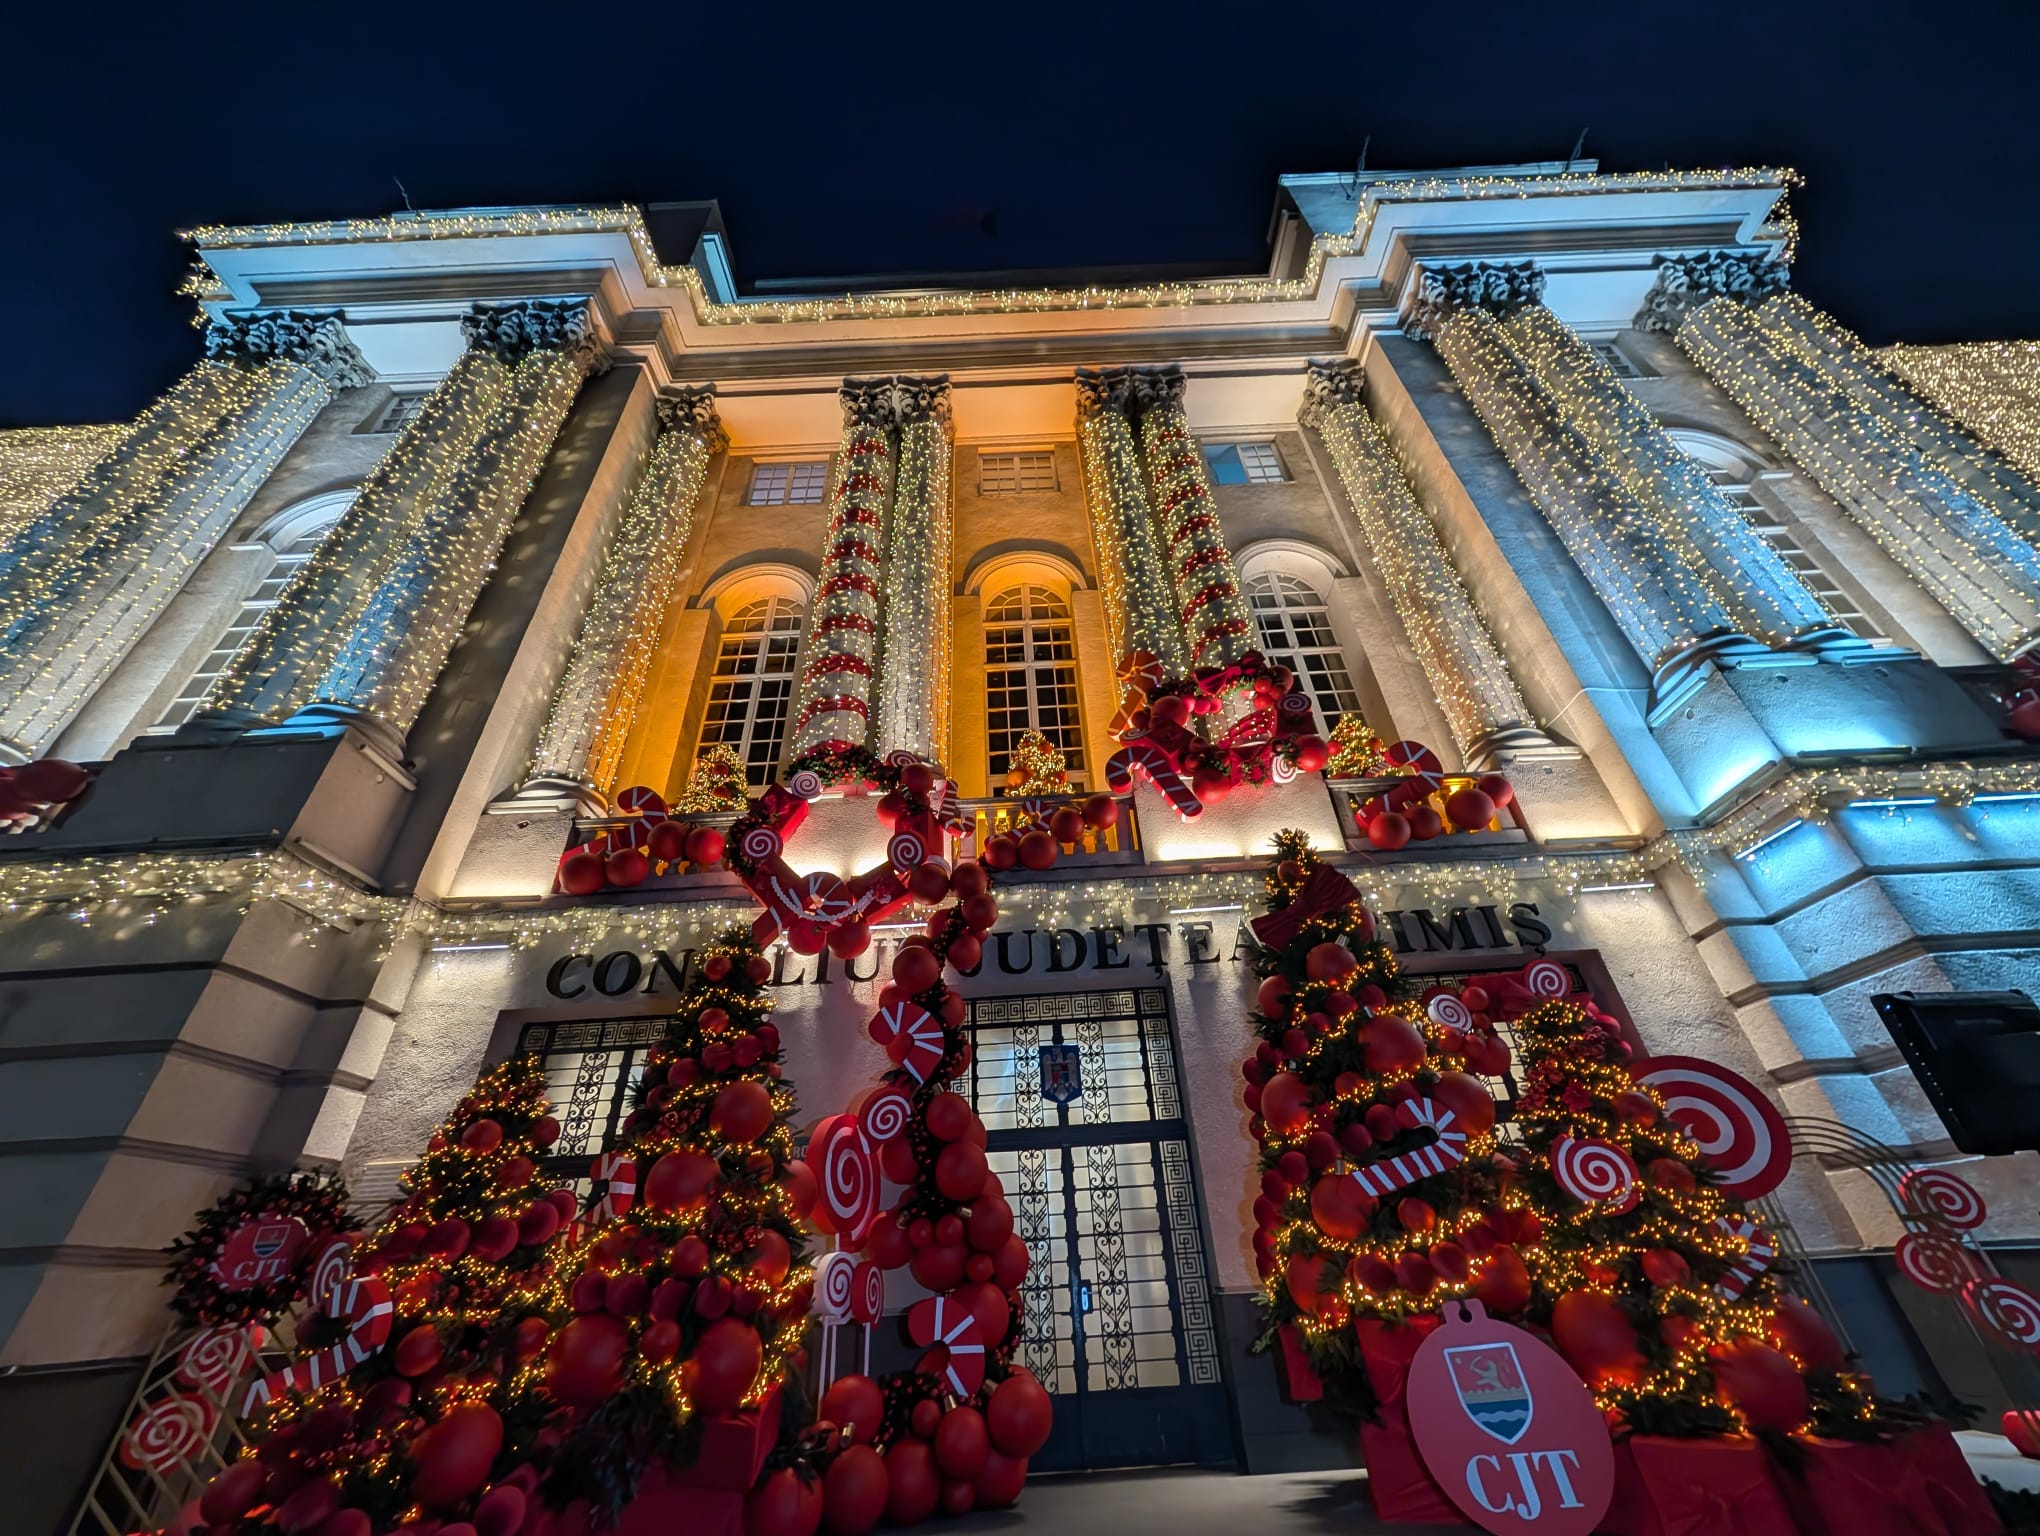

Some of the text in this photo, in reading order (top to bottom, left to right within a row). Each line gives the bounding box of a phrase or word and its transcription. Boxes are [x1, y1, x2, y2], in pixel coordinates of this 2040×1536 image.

[546, 903, 1552, 999] CONLIU UDEȚEA IMIȘ
[233, 1258, 286, 1281] CJT
[1465, 1449, 1585, 1520] CJT
